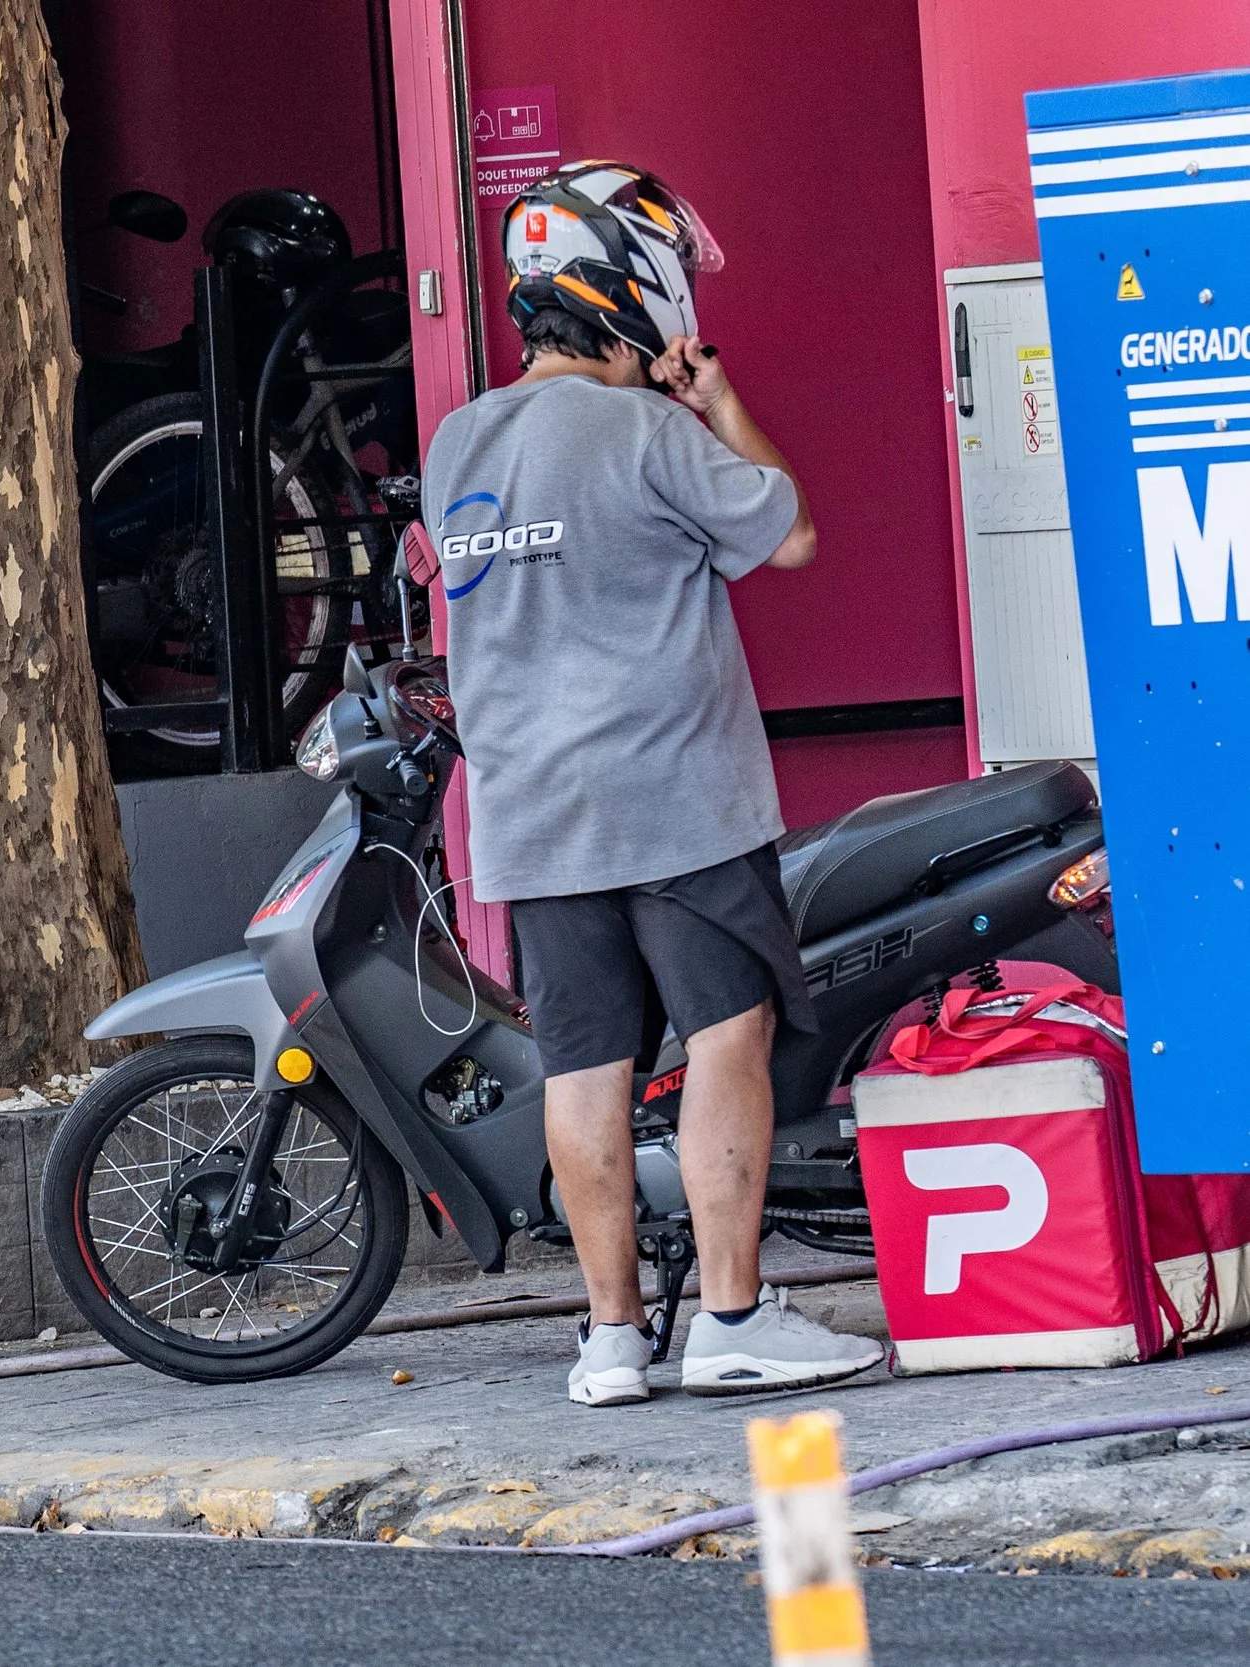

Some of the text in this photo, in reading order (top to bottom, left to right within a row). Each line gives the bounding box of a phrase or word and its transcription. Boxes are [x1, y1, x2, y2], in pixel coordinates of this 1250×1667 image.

[509, 166, 550, 179] TIMBRE
[478, 182, 534, 196] ROVEEDO
[443, 520, 564, 560] GOOD
[238, 1182, 257, 1217] CBS
